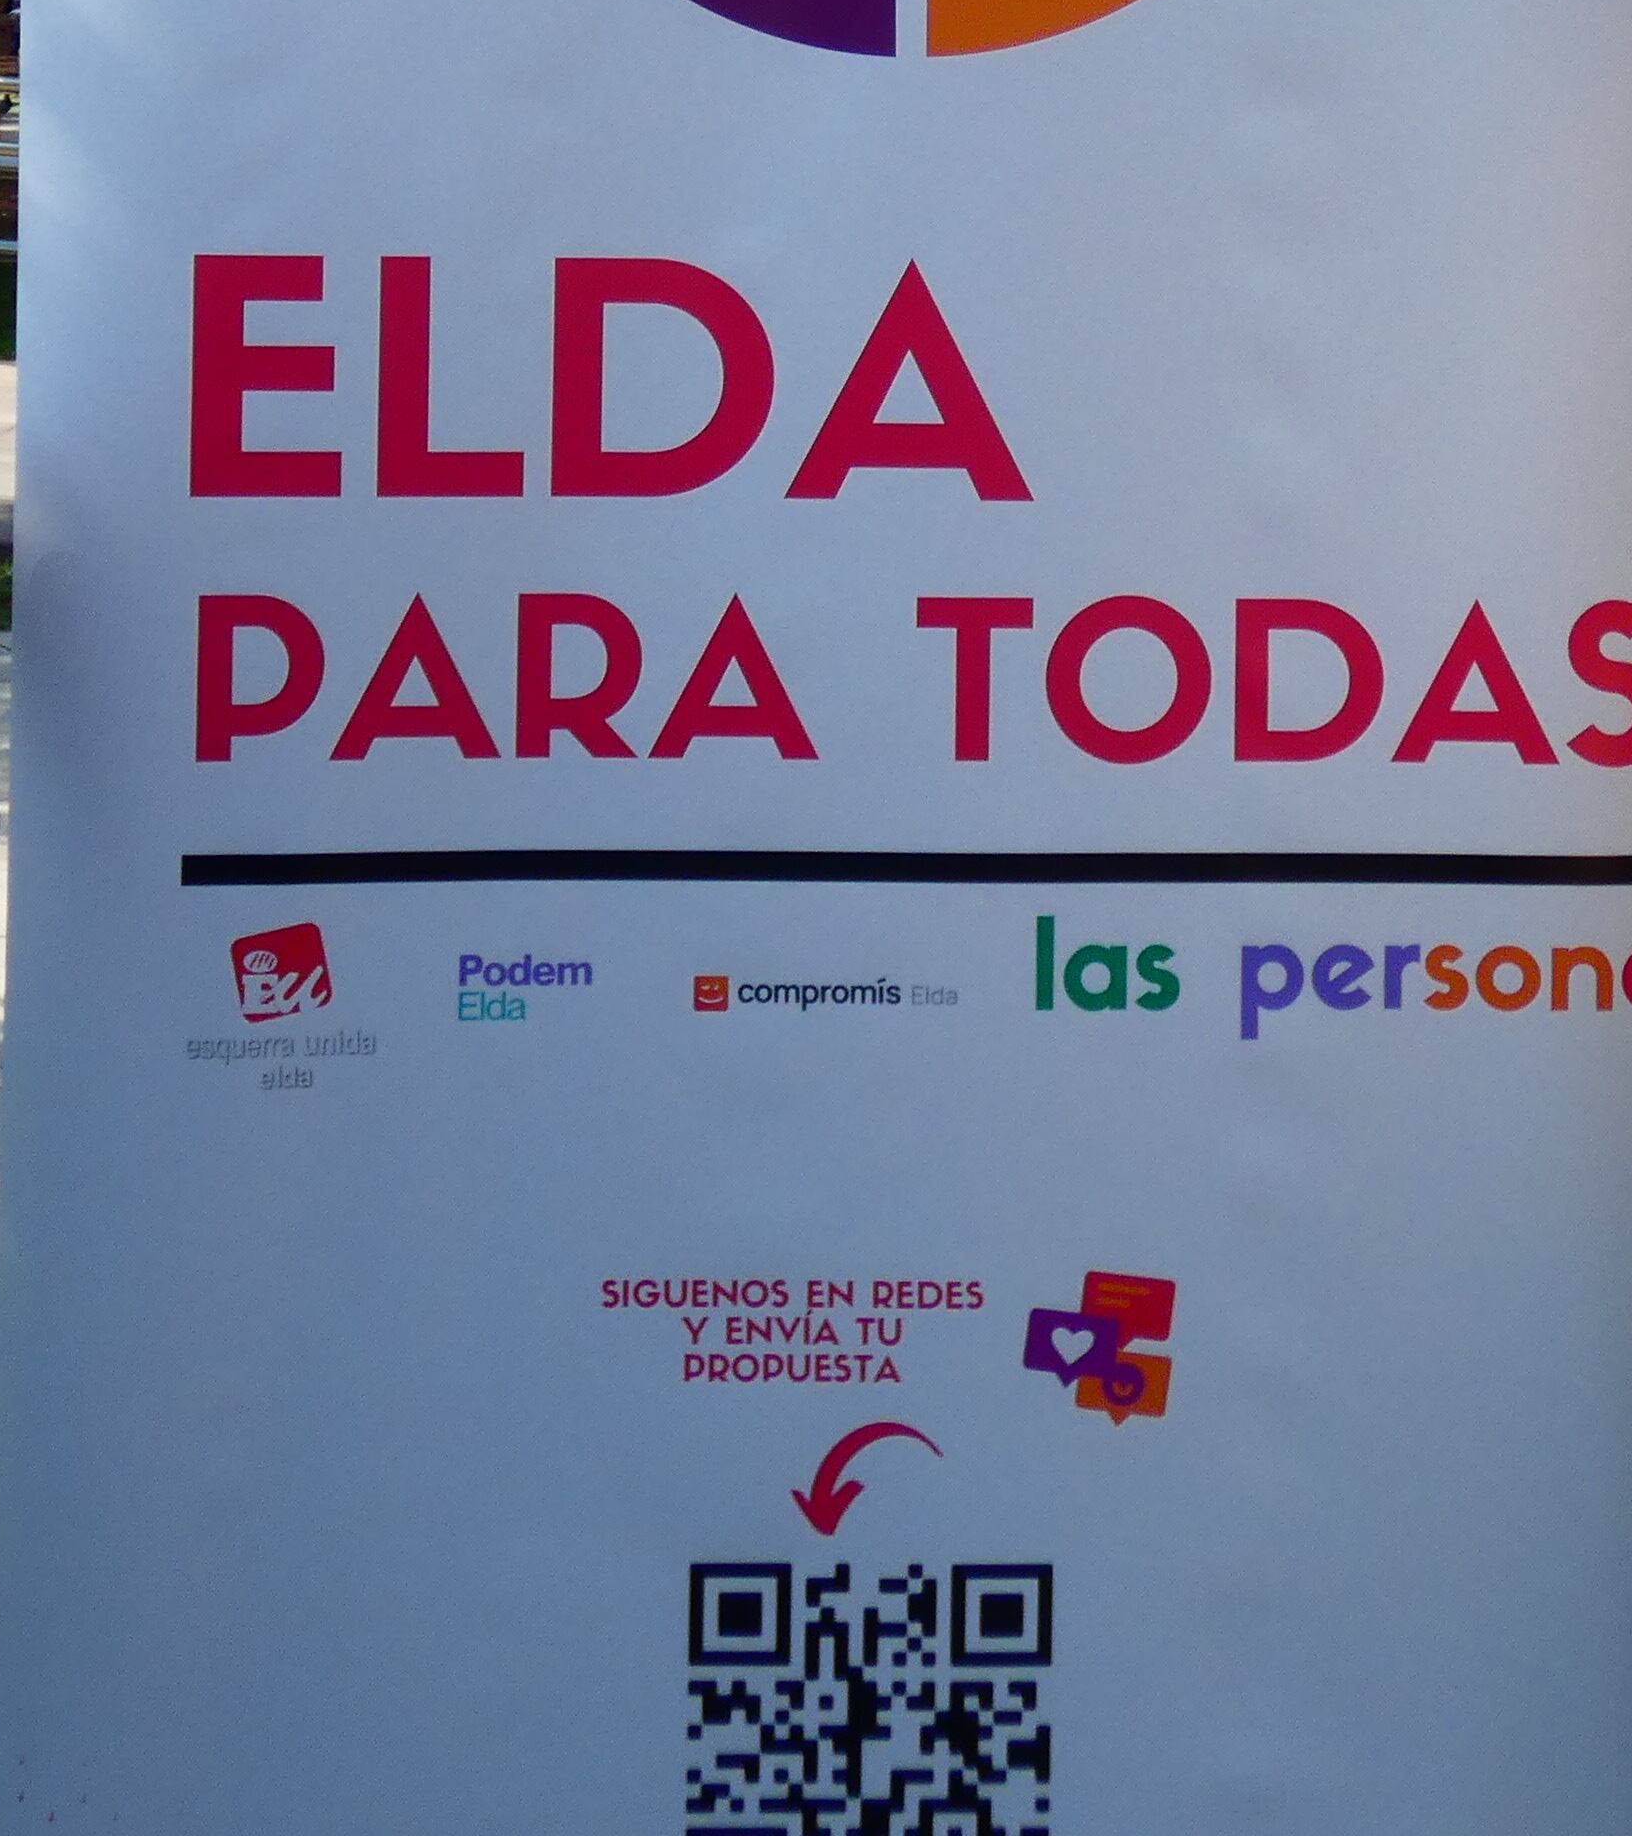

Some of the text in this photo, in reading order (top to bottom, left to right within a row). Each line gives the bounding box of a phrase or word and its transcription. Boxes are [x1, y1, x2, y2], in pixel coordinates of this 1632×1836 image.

[190, 255, 1034, 501] ELDA
[195, 592, 819, 763] PARA
[459, 954, 593, 986] Podem
[1036, 915, 1180, 1012] las
[458, 991, 527, 1021] Elda
[738, 978, 959, 1011] compromís Elda
[186, 1030, 377, 1066] esquerra unida
[261, 1066, 314, 1090] elda
[601, 1279, 985, 1310] SIGUENOS EN REDES
[682, 1309, 903, 1347] Y ENVÍA TU
[683, 1353, 902, 1383] PROPUESTA
